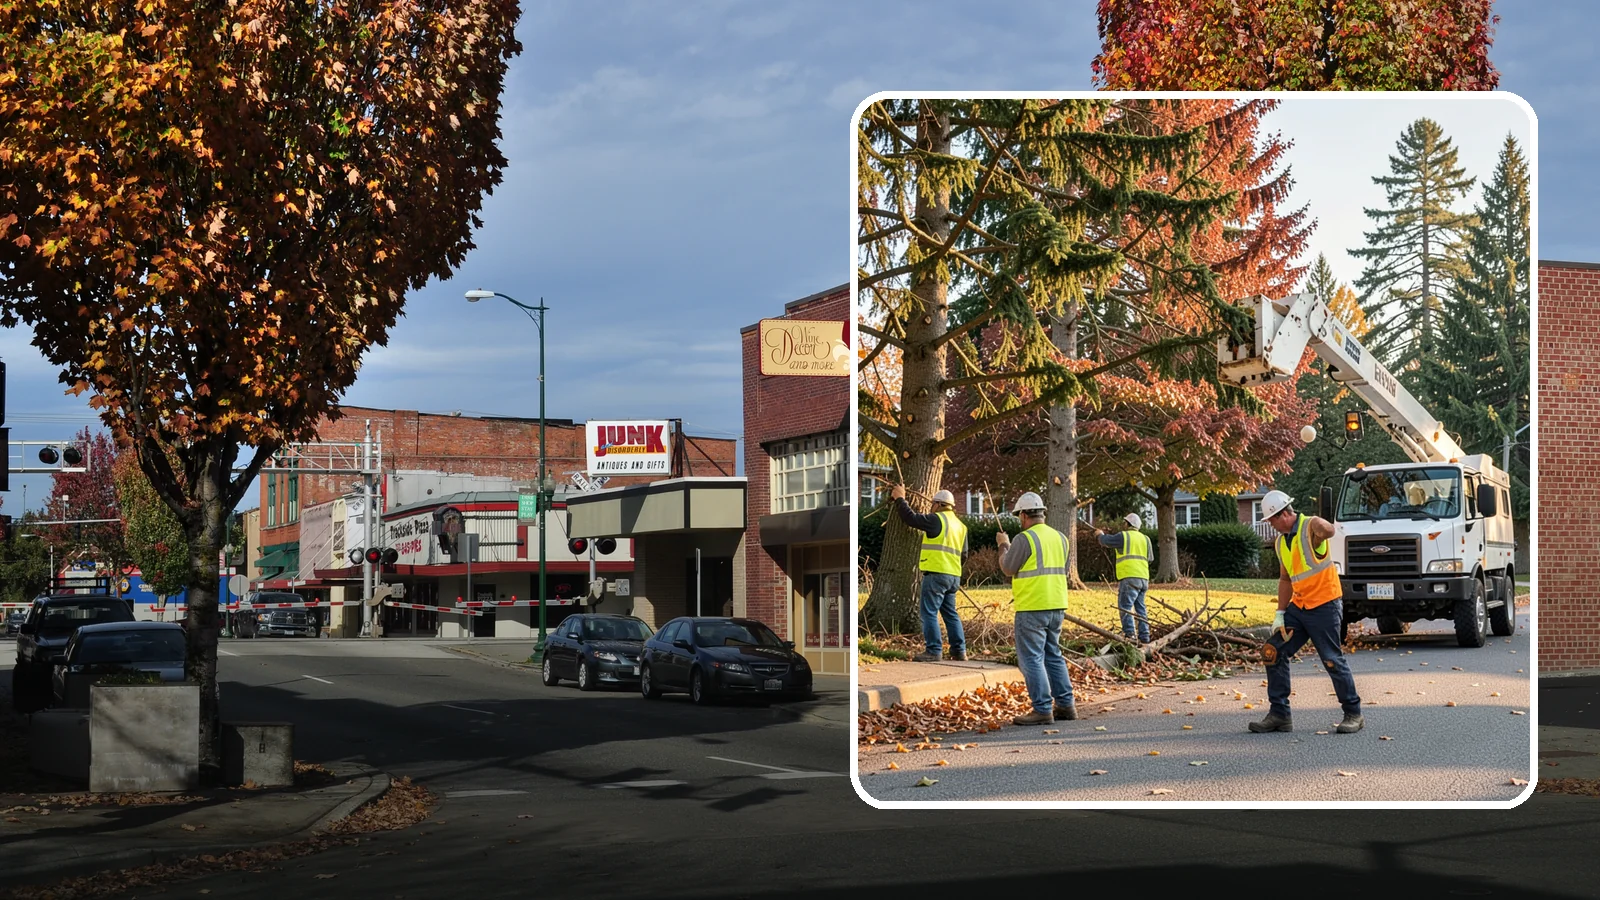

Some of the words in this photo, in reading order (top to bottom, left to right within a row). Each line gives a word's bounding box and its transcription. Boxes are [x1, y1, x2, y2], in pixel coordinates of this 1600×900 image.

[595, 425, 665, 457] JUNK
[607, 446, 645, 454] DISORDERLY
[596, 461, 628, 470] ANTIQUES
[631, 461, 644, 470] AND
[647, 460, 665, 469] GIFTS
[573, 473, 589, 492] RAIL
[390, 521, 413, 540] Trackside
[415, 519, 429, 535] Pizza
